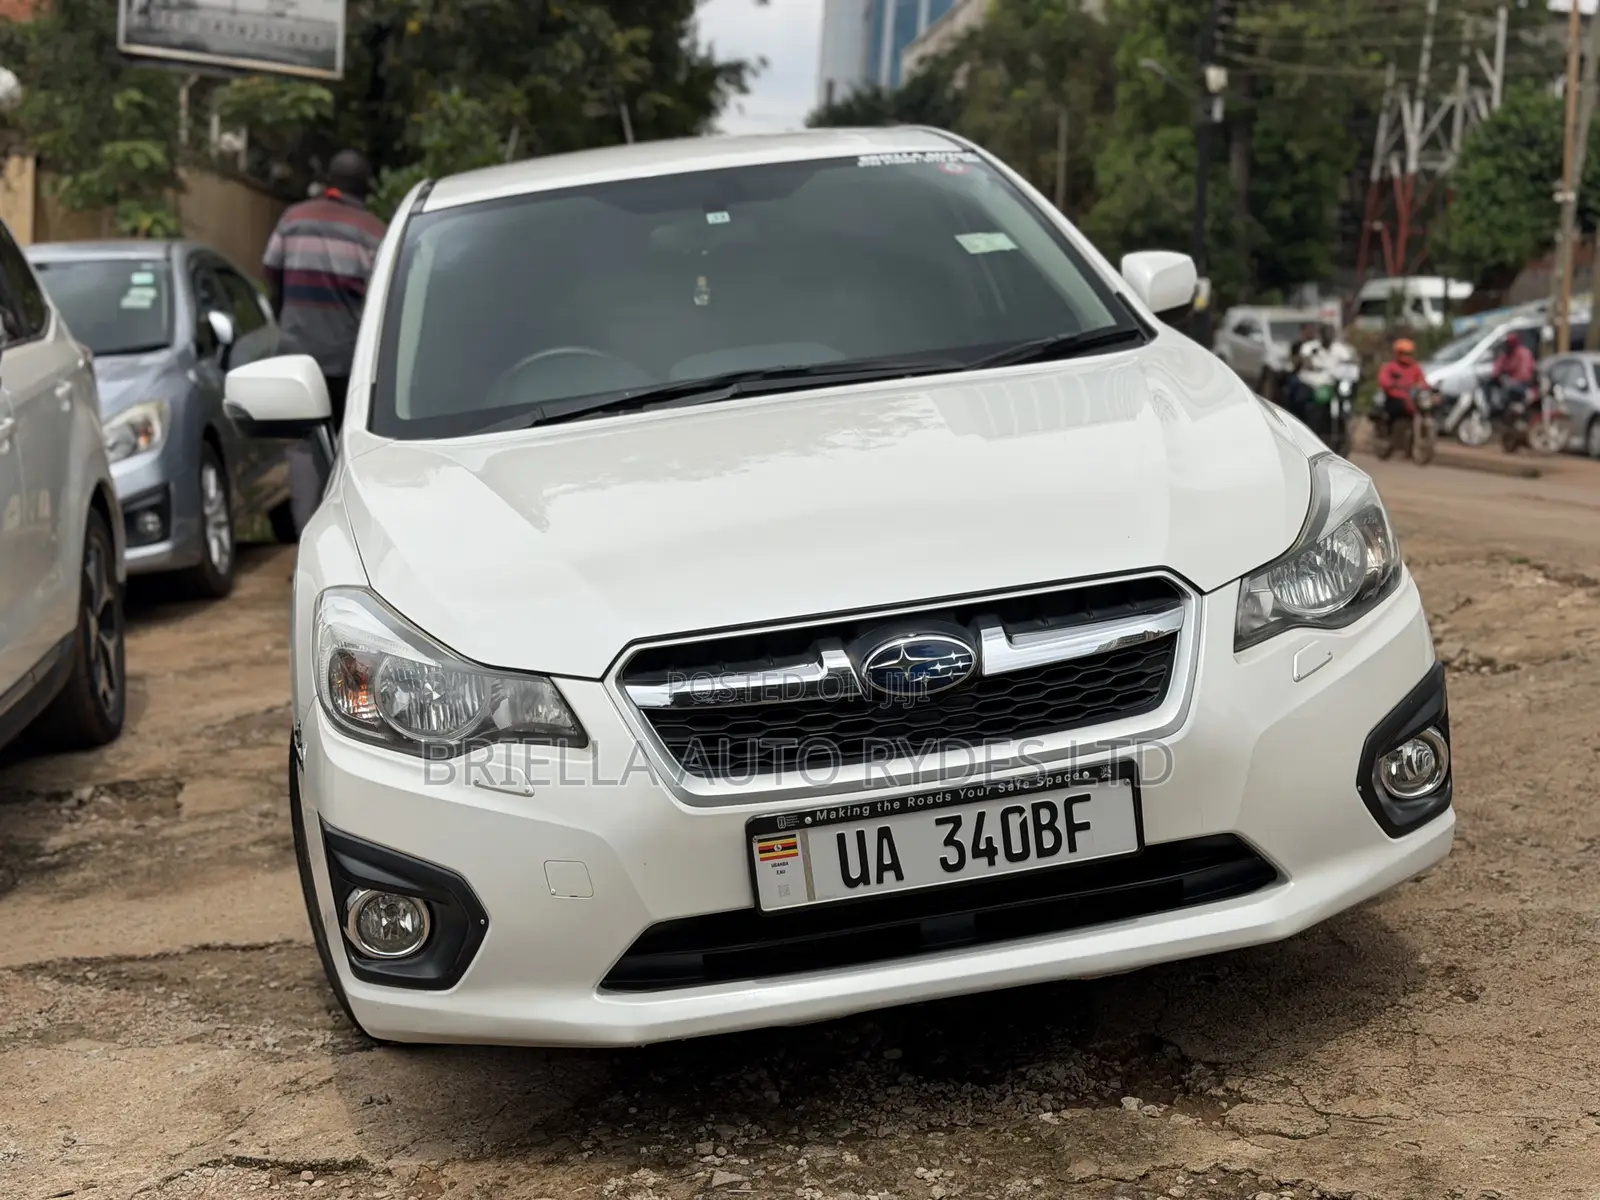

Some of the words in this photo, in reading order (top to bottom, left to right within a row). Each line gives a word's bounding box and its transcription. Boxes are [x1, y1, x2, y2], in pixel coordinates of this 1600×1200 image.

[816, 805, 870, 821] Making
[877, 800, 900, 812] the
[907, 792, 952, 807] Roads
[958, 786, 991, 799] Your
[998, 779, 1030, 793] Safe
[1036, 773, 1079, 788] Space
[836, 825, 904, 889] UA
[934, 792, 1092, 873] 340BF
